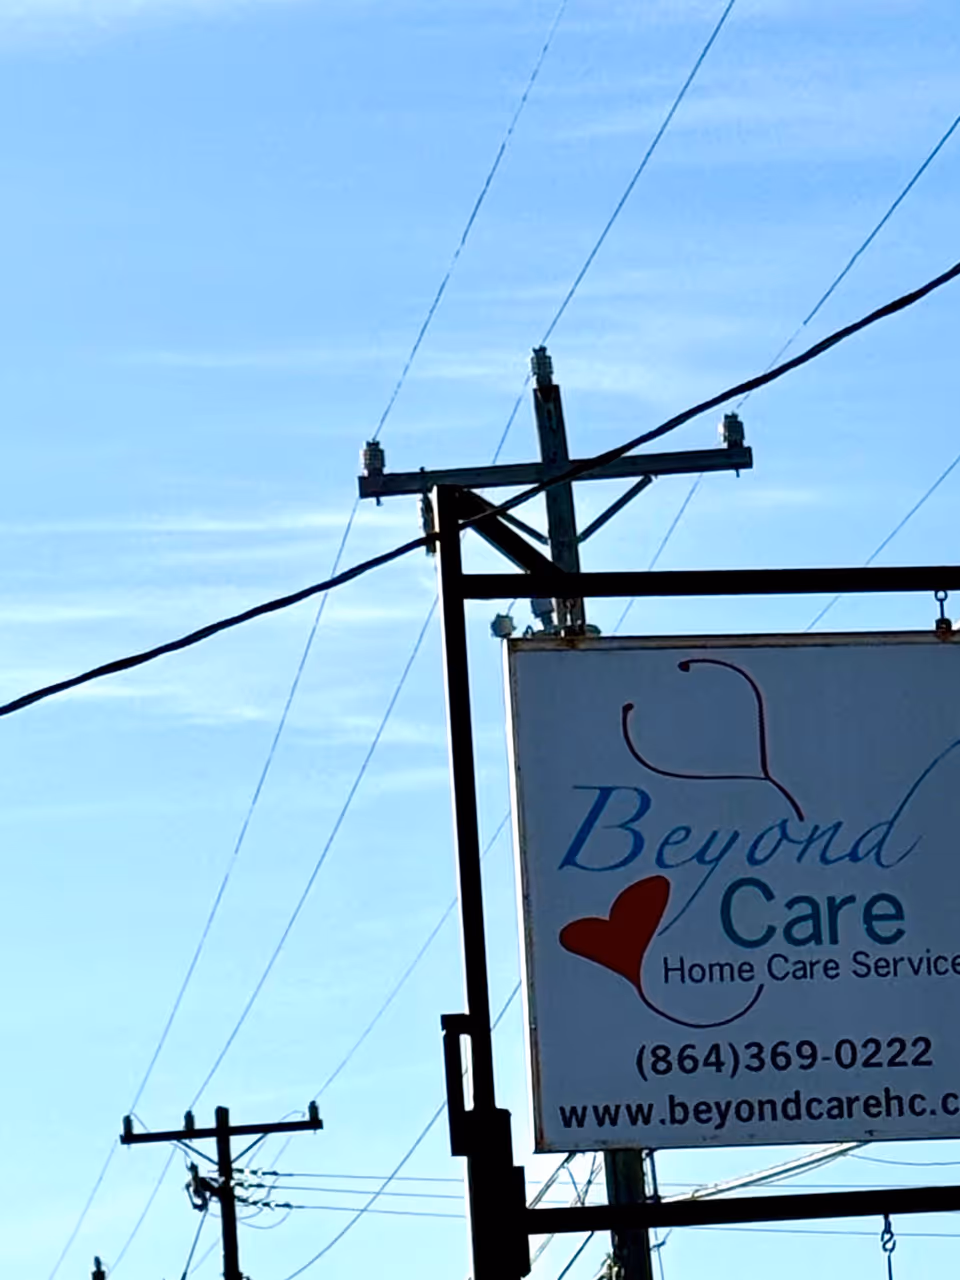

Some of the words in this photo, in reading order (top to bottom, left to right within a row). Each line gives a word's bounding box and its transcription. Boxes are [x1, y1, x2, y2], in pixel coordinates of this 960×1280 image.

[720, 877, 906, 948] Care
[663, 956, 755, 984] Home
[767, 952, 840, 981] Care
[636, 1036, 934, 1081] (864)369-0222
